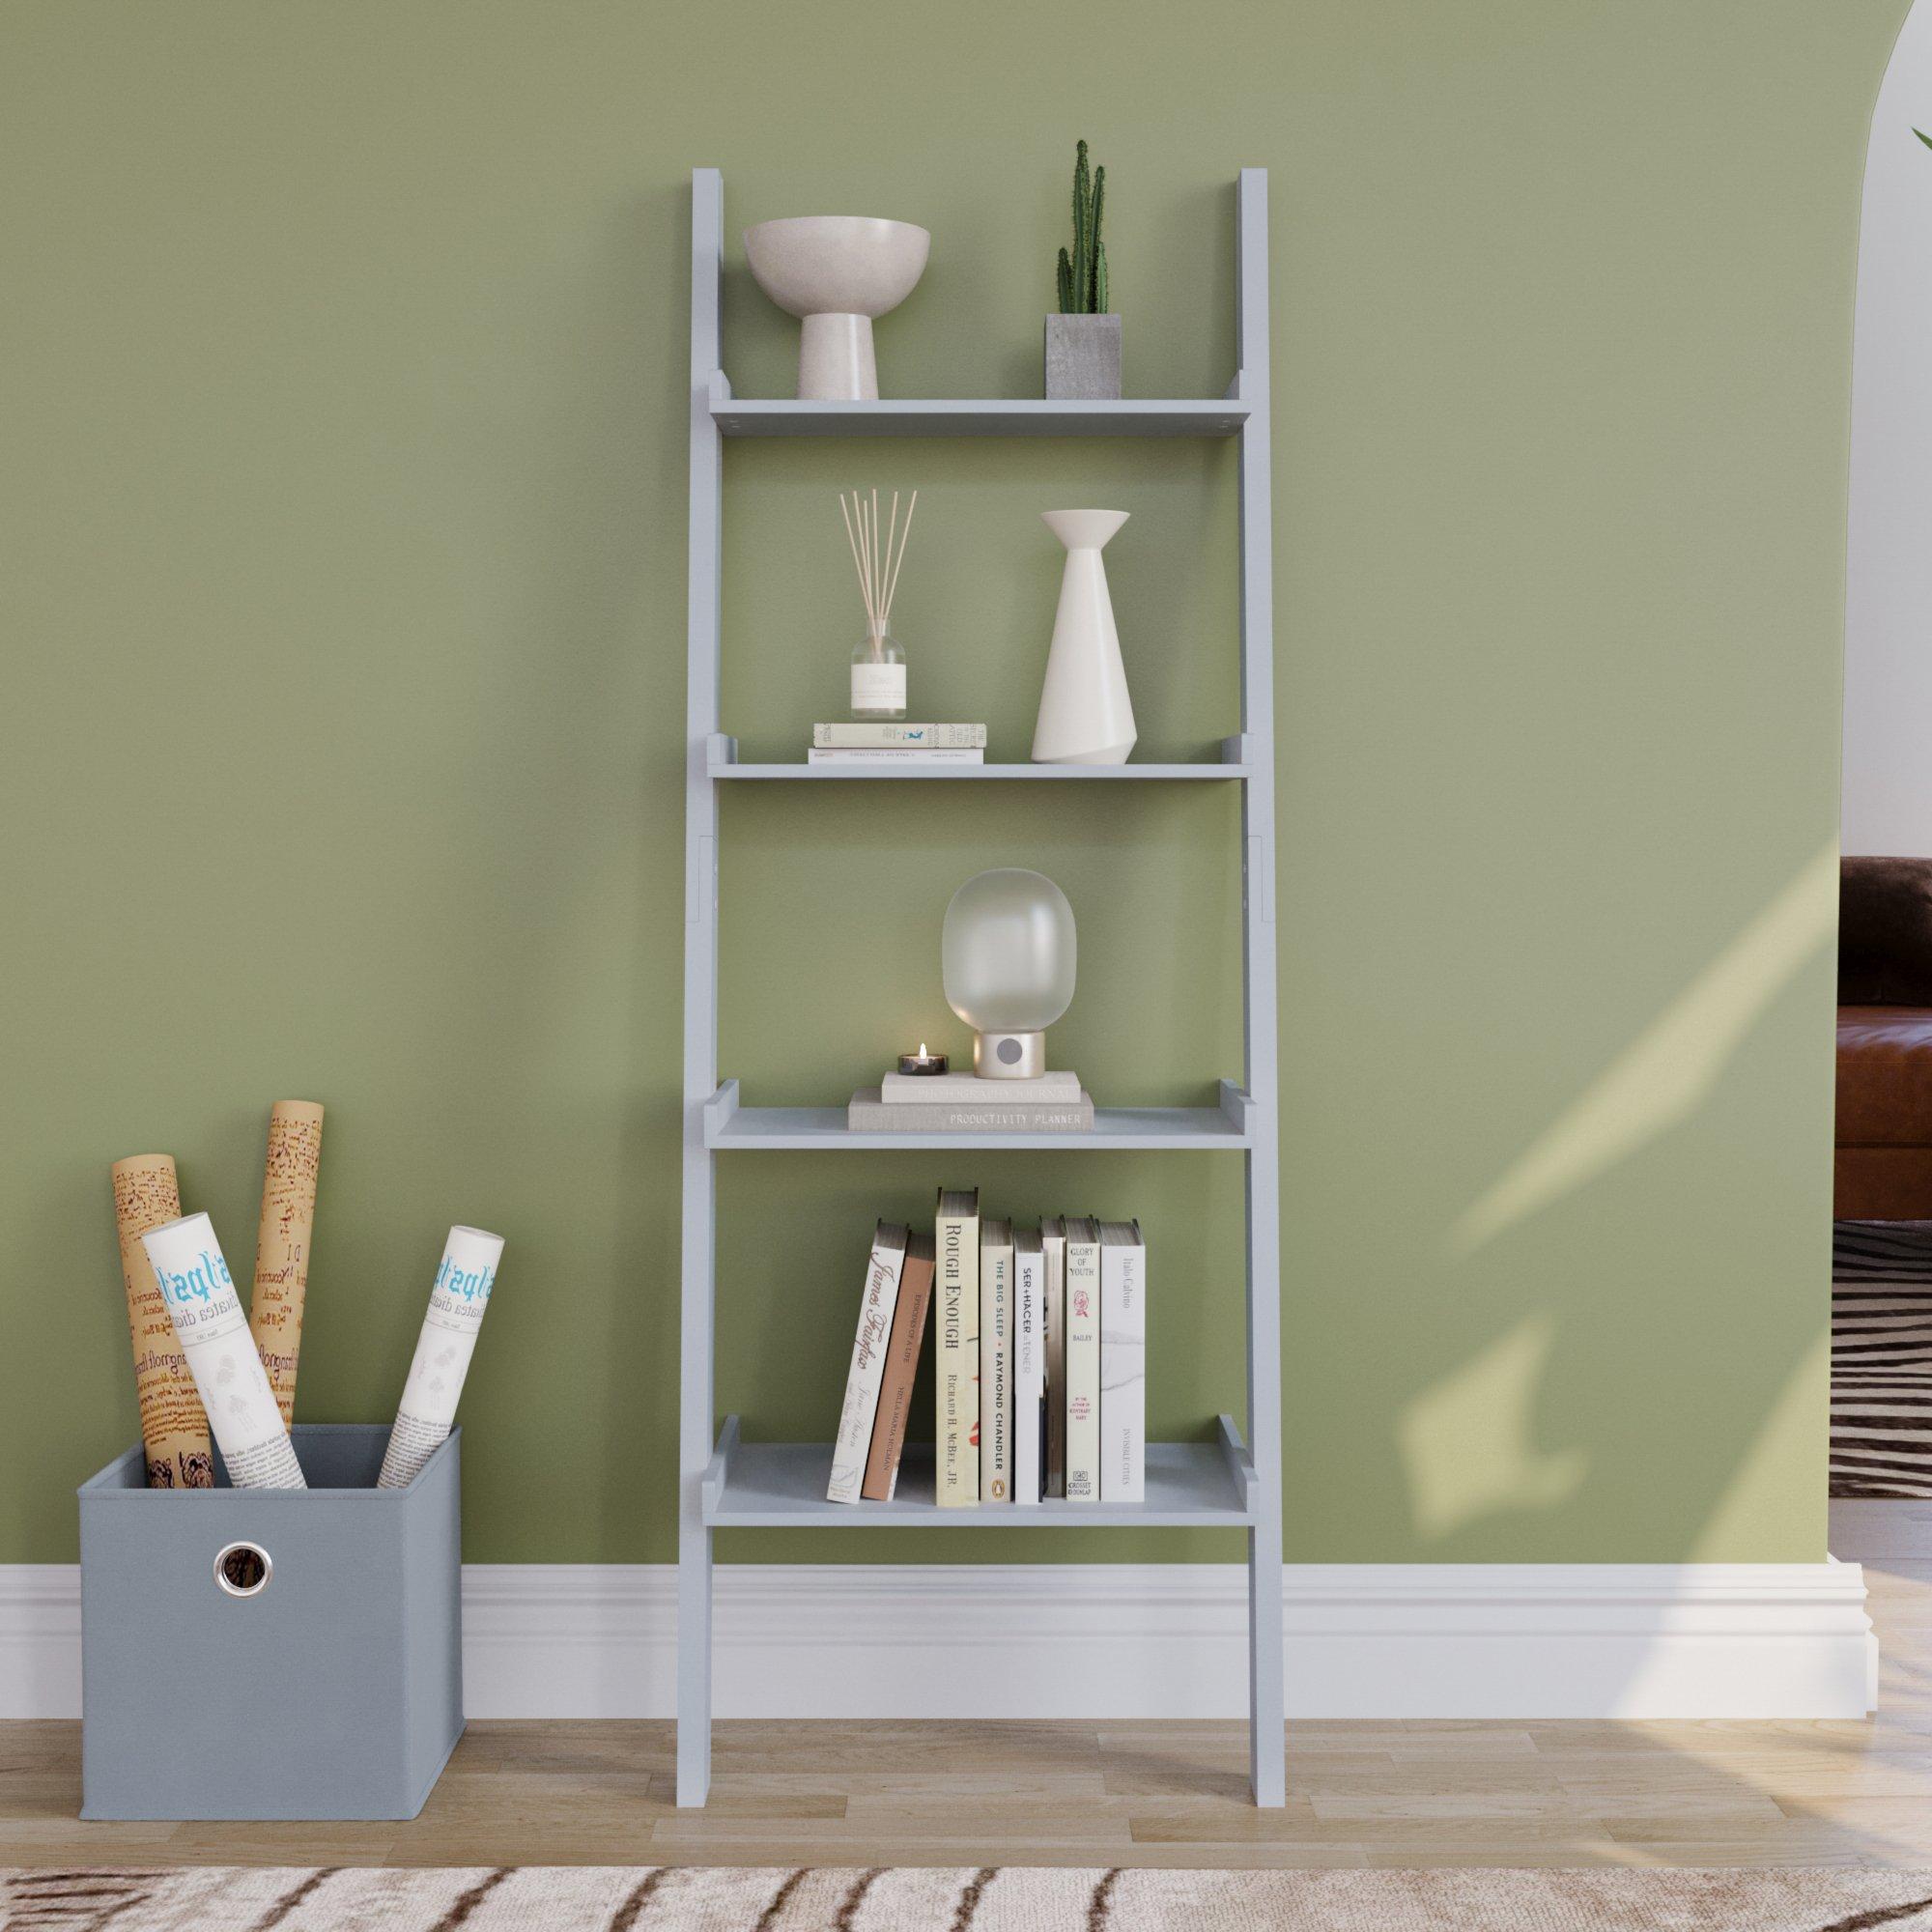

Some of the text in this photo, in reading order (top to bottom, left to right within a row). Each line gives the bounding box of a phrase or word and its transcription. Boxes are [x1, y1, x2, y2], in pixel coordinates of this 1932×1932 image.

[950, 1114, 1081, 1124] PRODUCTIVITY PLANNER
[1070, 1247, 1094, 1257] GLORY
[1077, 1258, 1086, 1266] OF
[1069, 1267, 1094, 1276] YOUTH
[945, 1224, 962, 1349] ROUGH ENOUGH
[1122, 1258, 1134, 1309] Italo Calvino
[855, 1253, 894, 1369] James Fairfax
[910, 1295, 921, 1328] EPISODES
[1072, 1334, 1092, 1342] BAILEY
[903, 1348, 912, 1363] LIFE
[948, 1374, 958, 1415] RICHARD
[948, 1418, 958, 1430] H.
[1122, 1428, 1131, 1462] INVISIBLE
